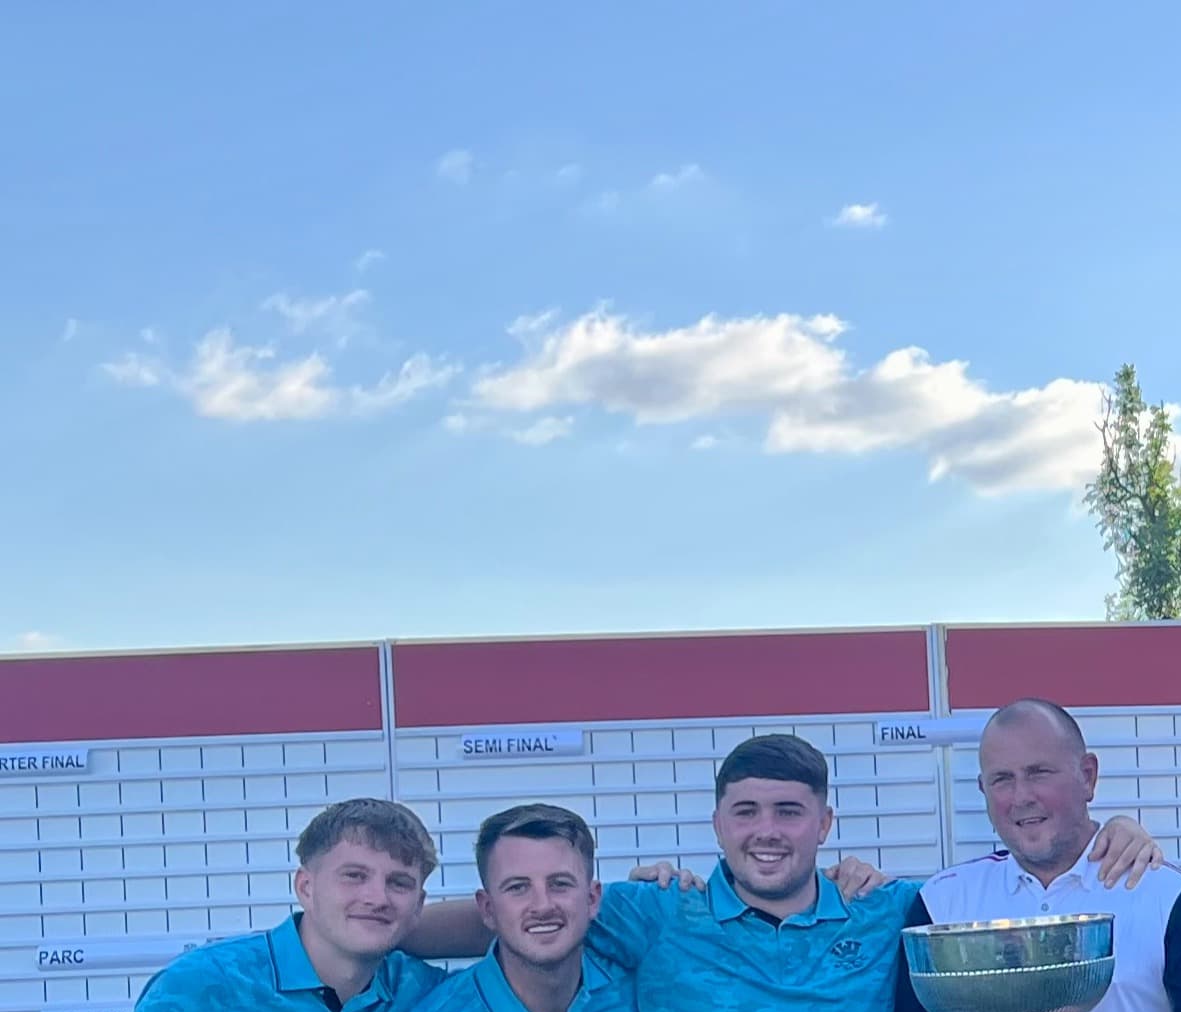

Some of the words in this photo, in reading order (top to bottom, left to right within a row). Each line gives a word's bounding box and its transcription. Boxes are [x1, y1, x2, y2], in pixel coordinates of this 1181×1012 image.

[881, 725, 927, 741] FINAL
[463, 738, 502, 754] SEMI
[42, 754, 84, 769] FINAL
[39, 949, 85, 965] PARC
